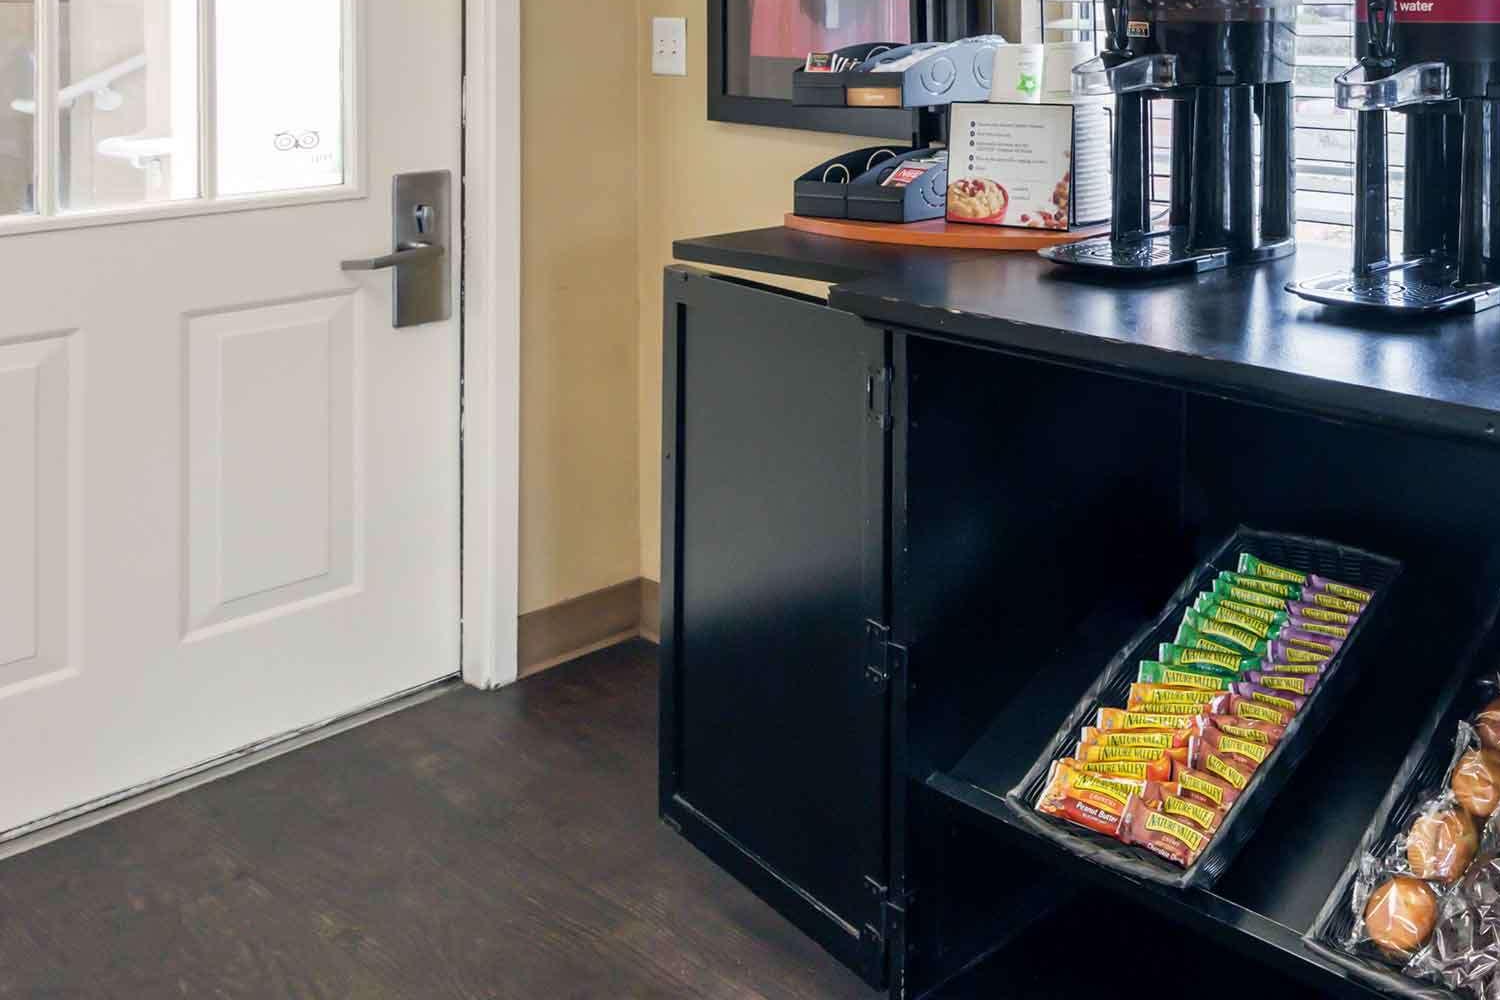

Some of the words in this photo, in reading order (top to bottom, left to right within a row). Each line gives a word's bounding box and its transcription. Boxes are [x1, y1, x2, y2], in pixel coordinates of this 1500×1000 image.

[1400, 1, 1434, 12] water
[1111, 735, 1143, 746] NATURE
[1076, 801, 1098, 816] Peanut
[1098, 810, 1119, 824] Butter
[1149, 813, 1175, 832] NATURE
[1175, 823, 1200, 848] VALLEY
